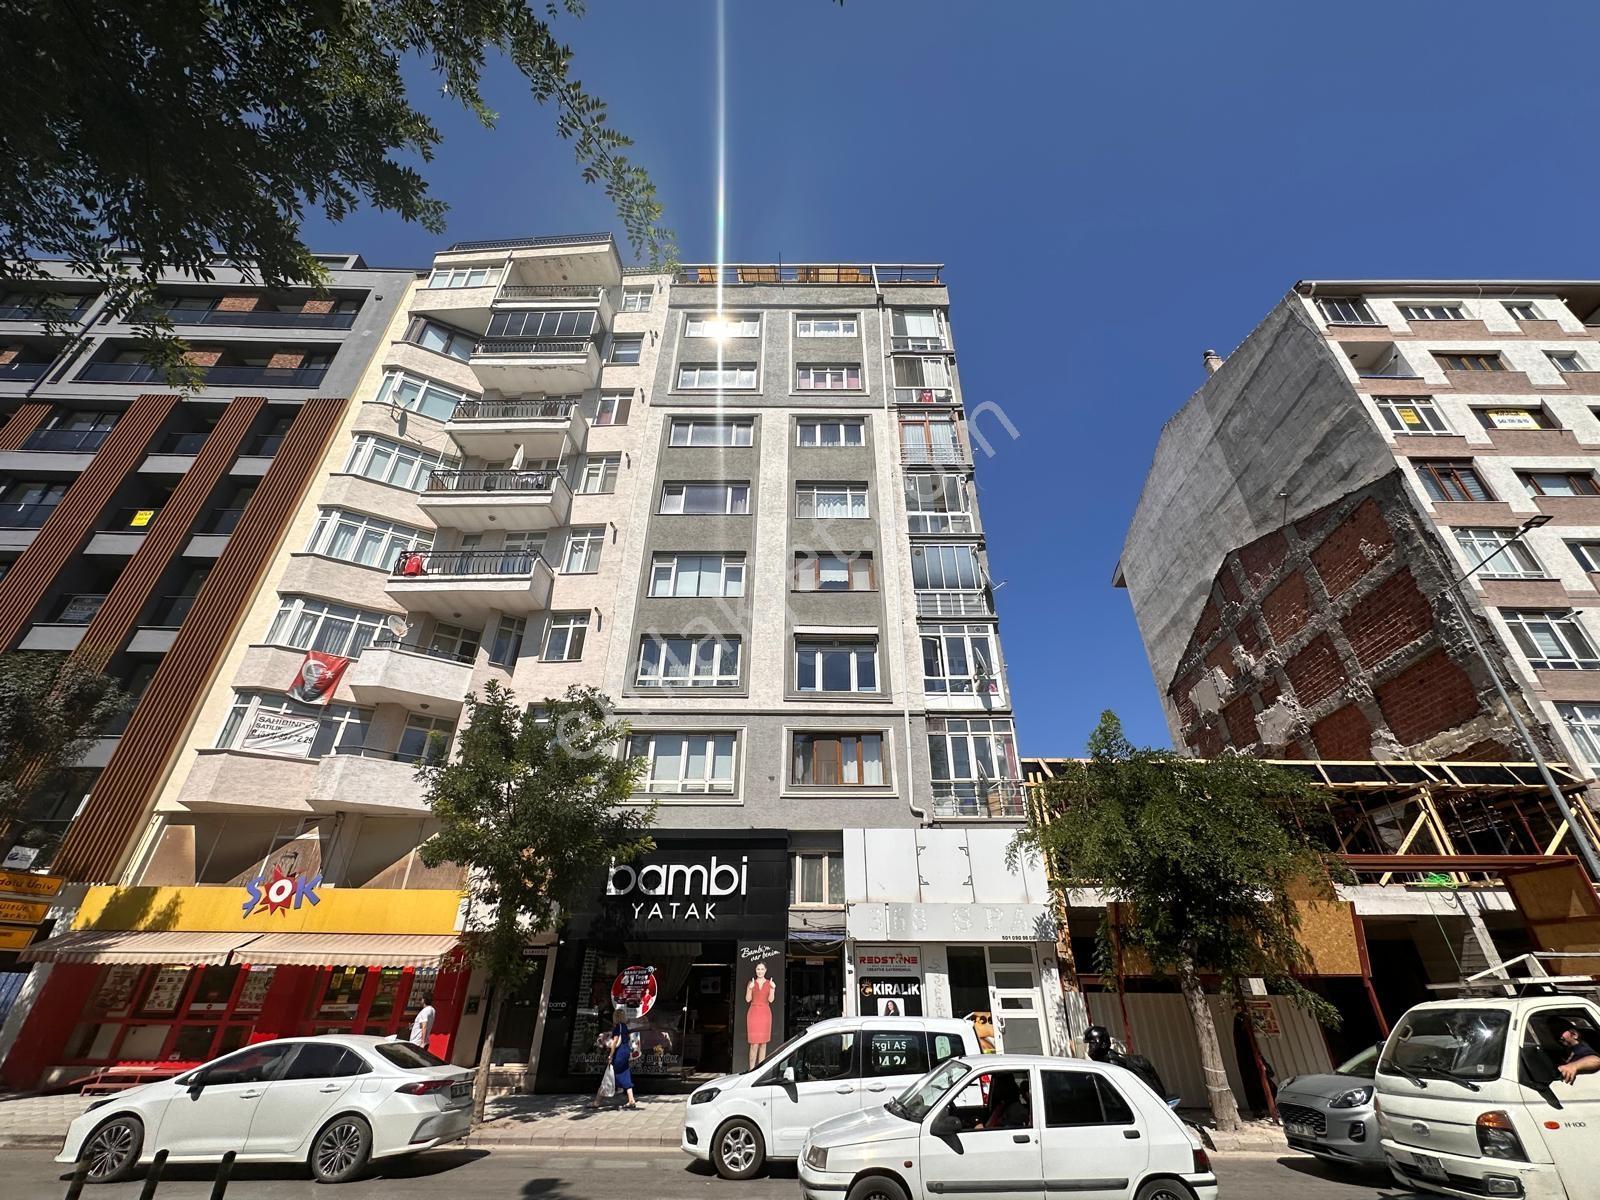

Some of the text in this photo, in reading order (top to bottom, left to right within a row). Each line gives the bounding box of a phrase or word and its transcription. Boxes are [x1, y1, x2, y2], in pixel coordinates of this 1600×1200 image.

[241, 872, 323, 919] ŞOK
[605, 855, 748, 896] bambi
[631, 902, 716, 920] YATAK
